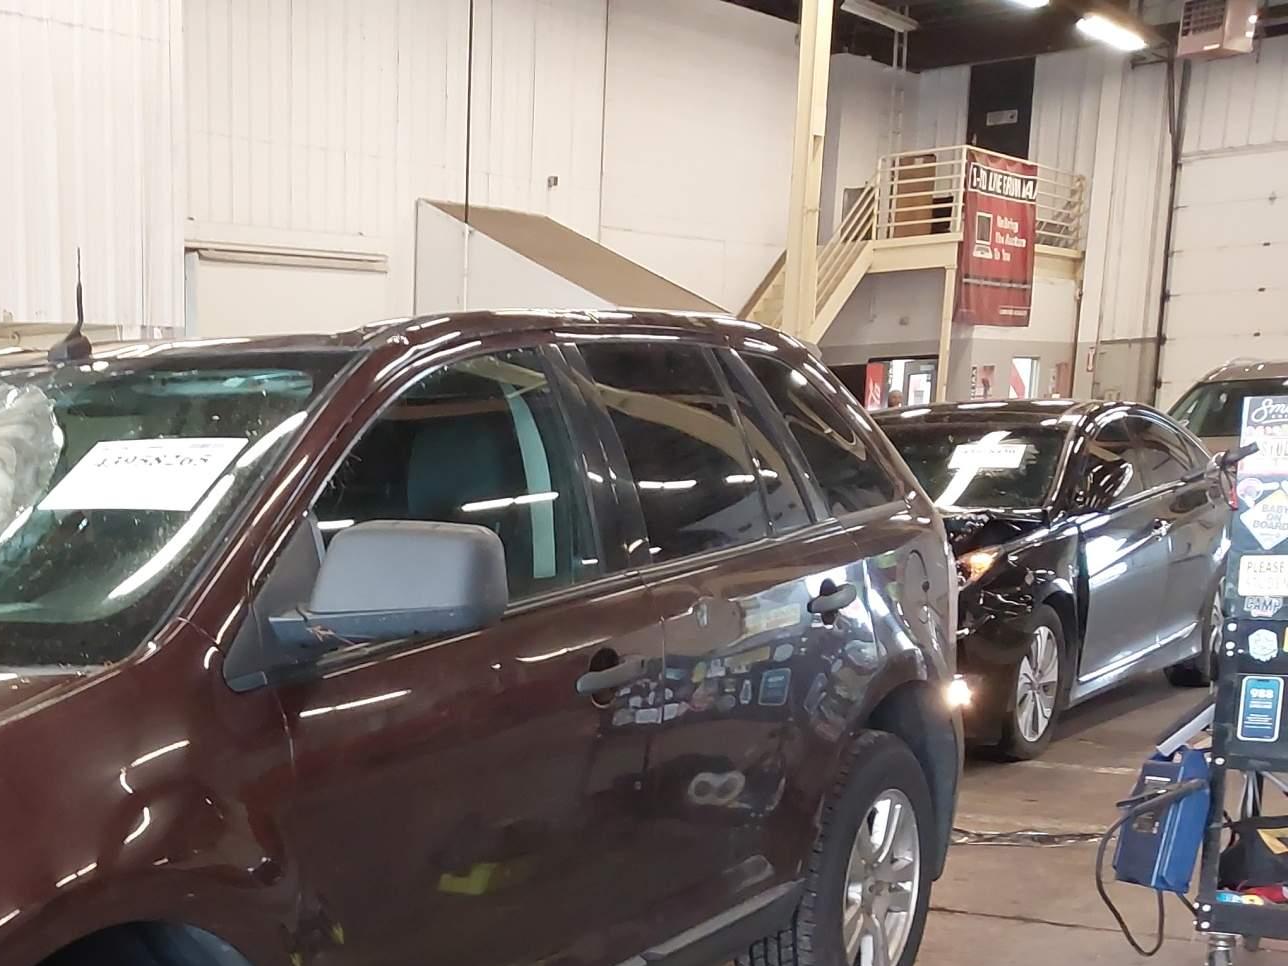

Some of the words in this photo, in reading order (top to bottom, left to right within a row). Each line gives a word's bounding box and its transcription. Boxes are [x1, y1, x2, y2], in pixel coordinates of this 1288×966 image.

[1266, 513, 1282, 522] ON
[1247, 561, 1285, 573] PLEASE
[1245, 597, 1283, 612] CAMP
